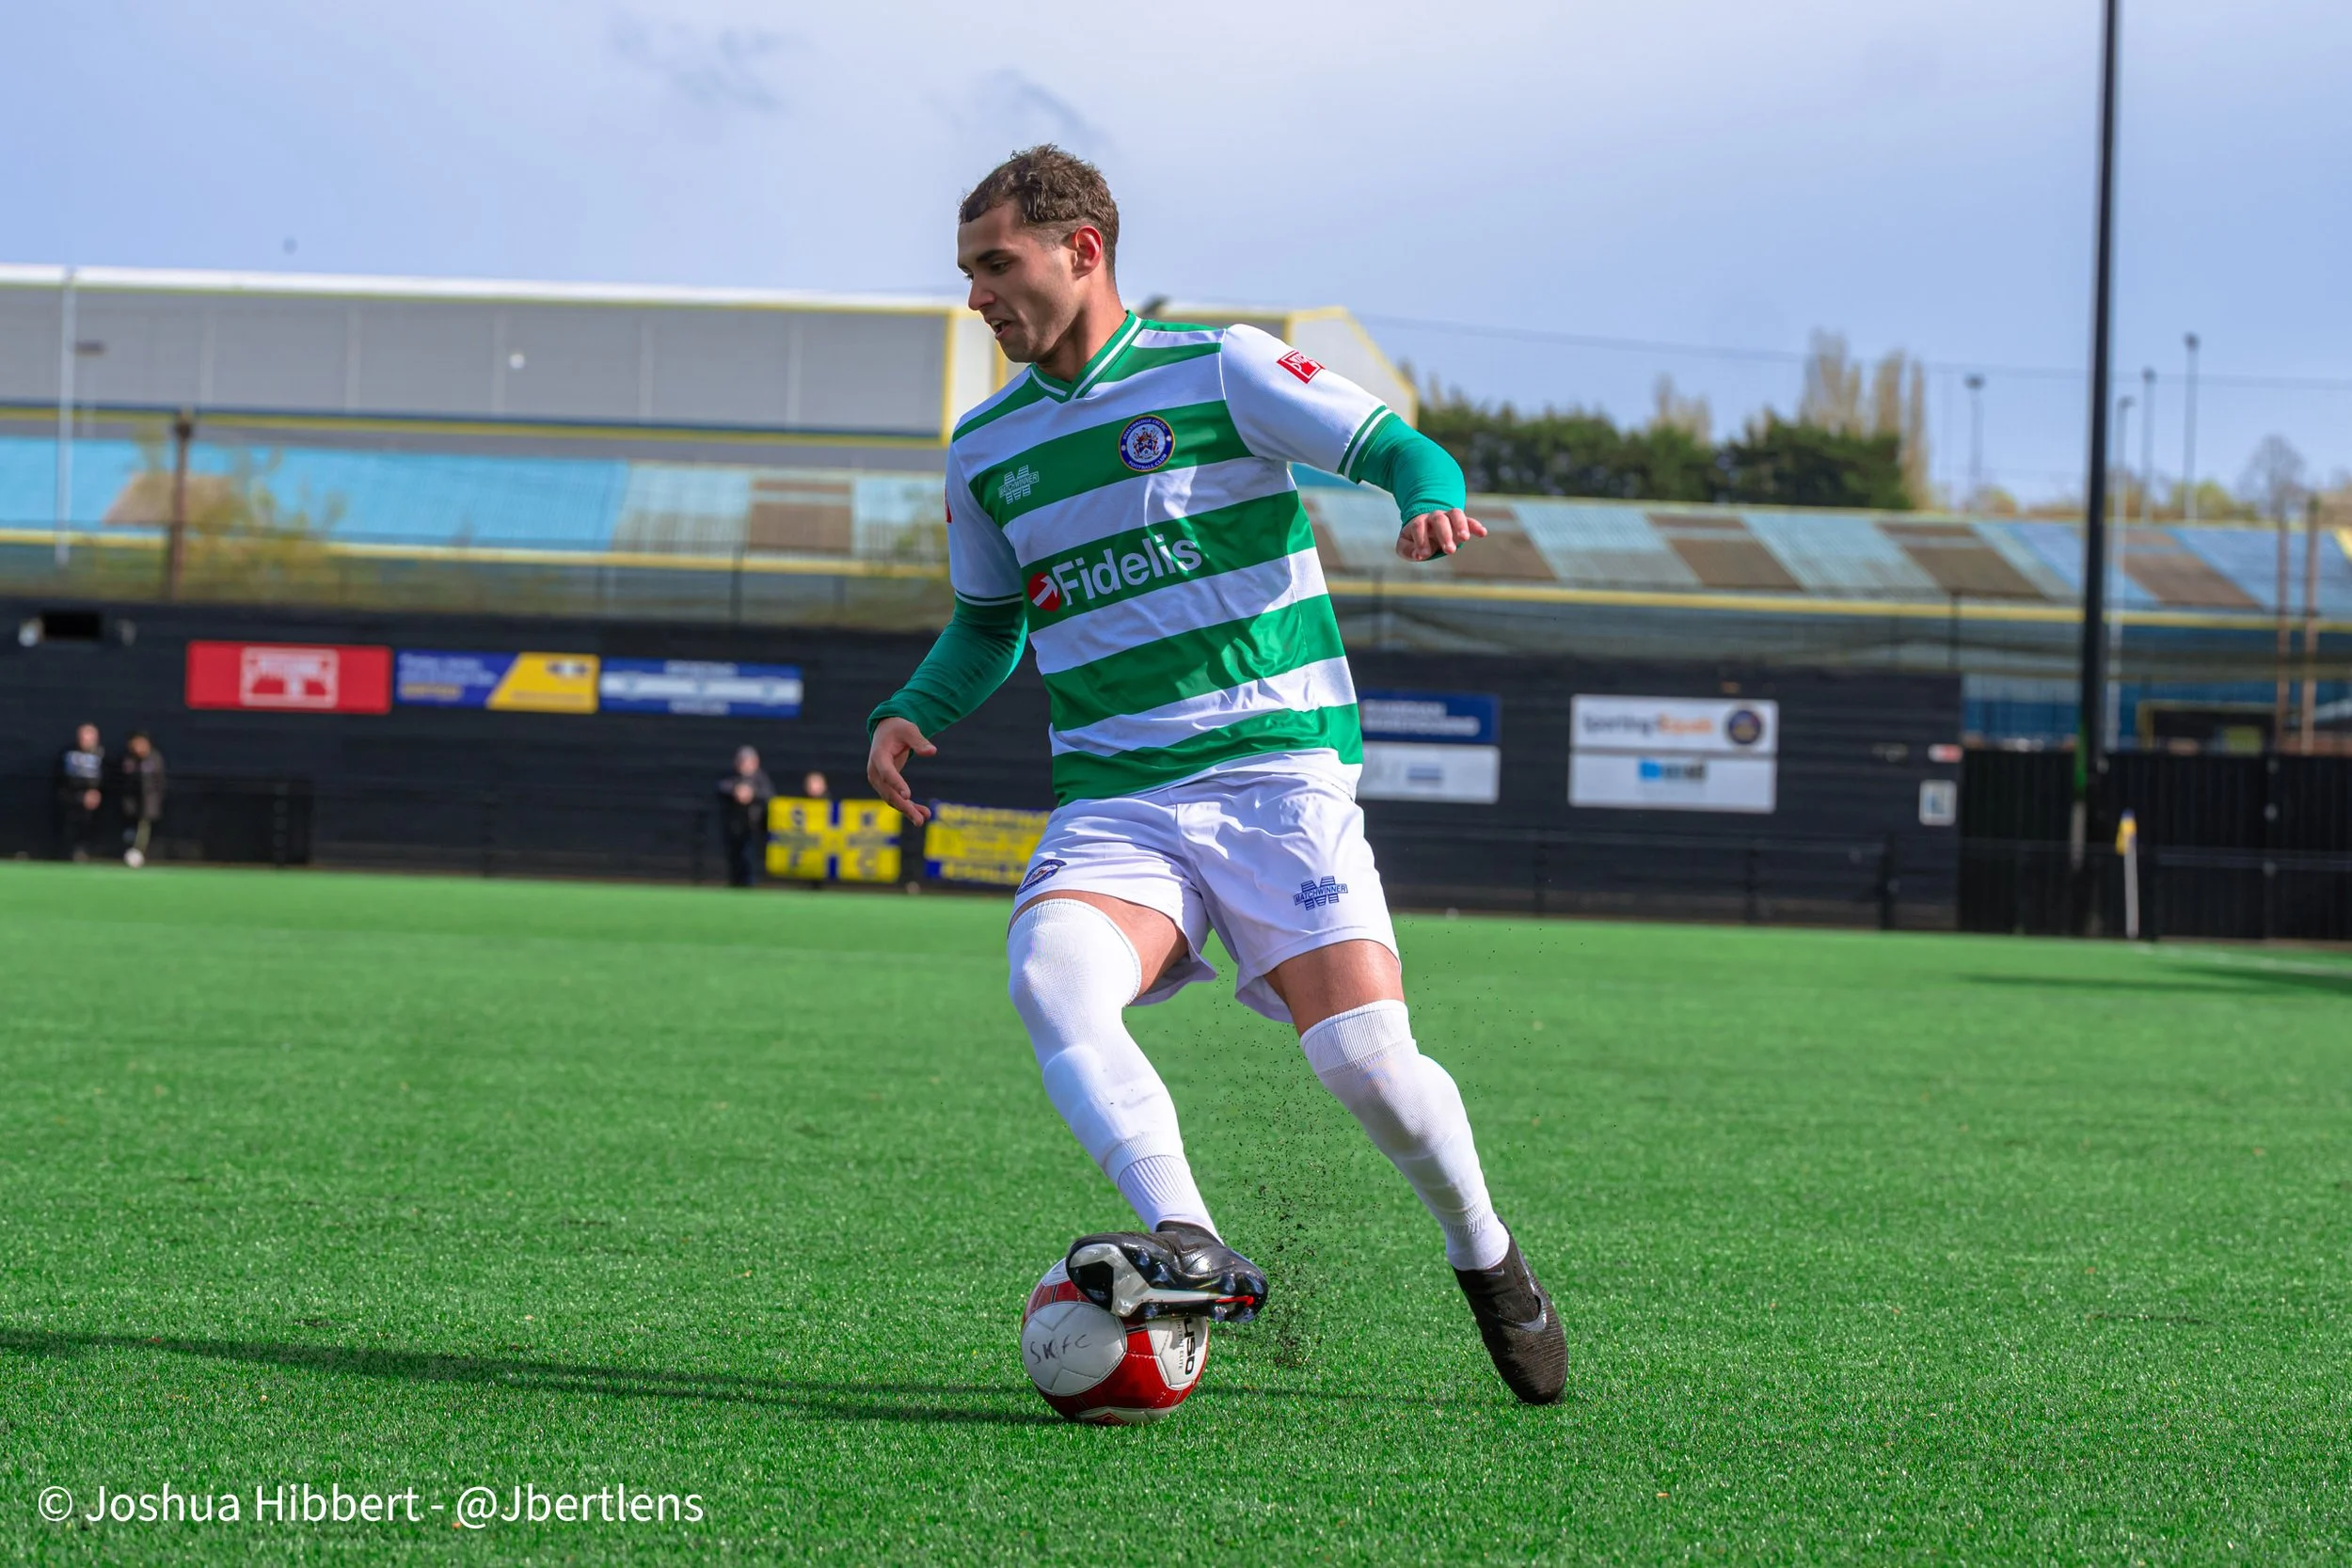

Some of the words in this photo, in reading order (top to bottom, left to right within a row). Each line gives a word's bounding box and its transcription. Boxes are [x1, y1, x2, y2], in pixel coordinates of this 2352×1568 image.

[1128, 460, 1155, 470] FOOTBALL
[1154, 453, 1168, 466] CLUB
[1051, 533, 1202, 607] Fidelis
[1295, 884, 1347, 903] MATCHWINNER
